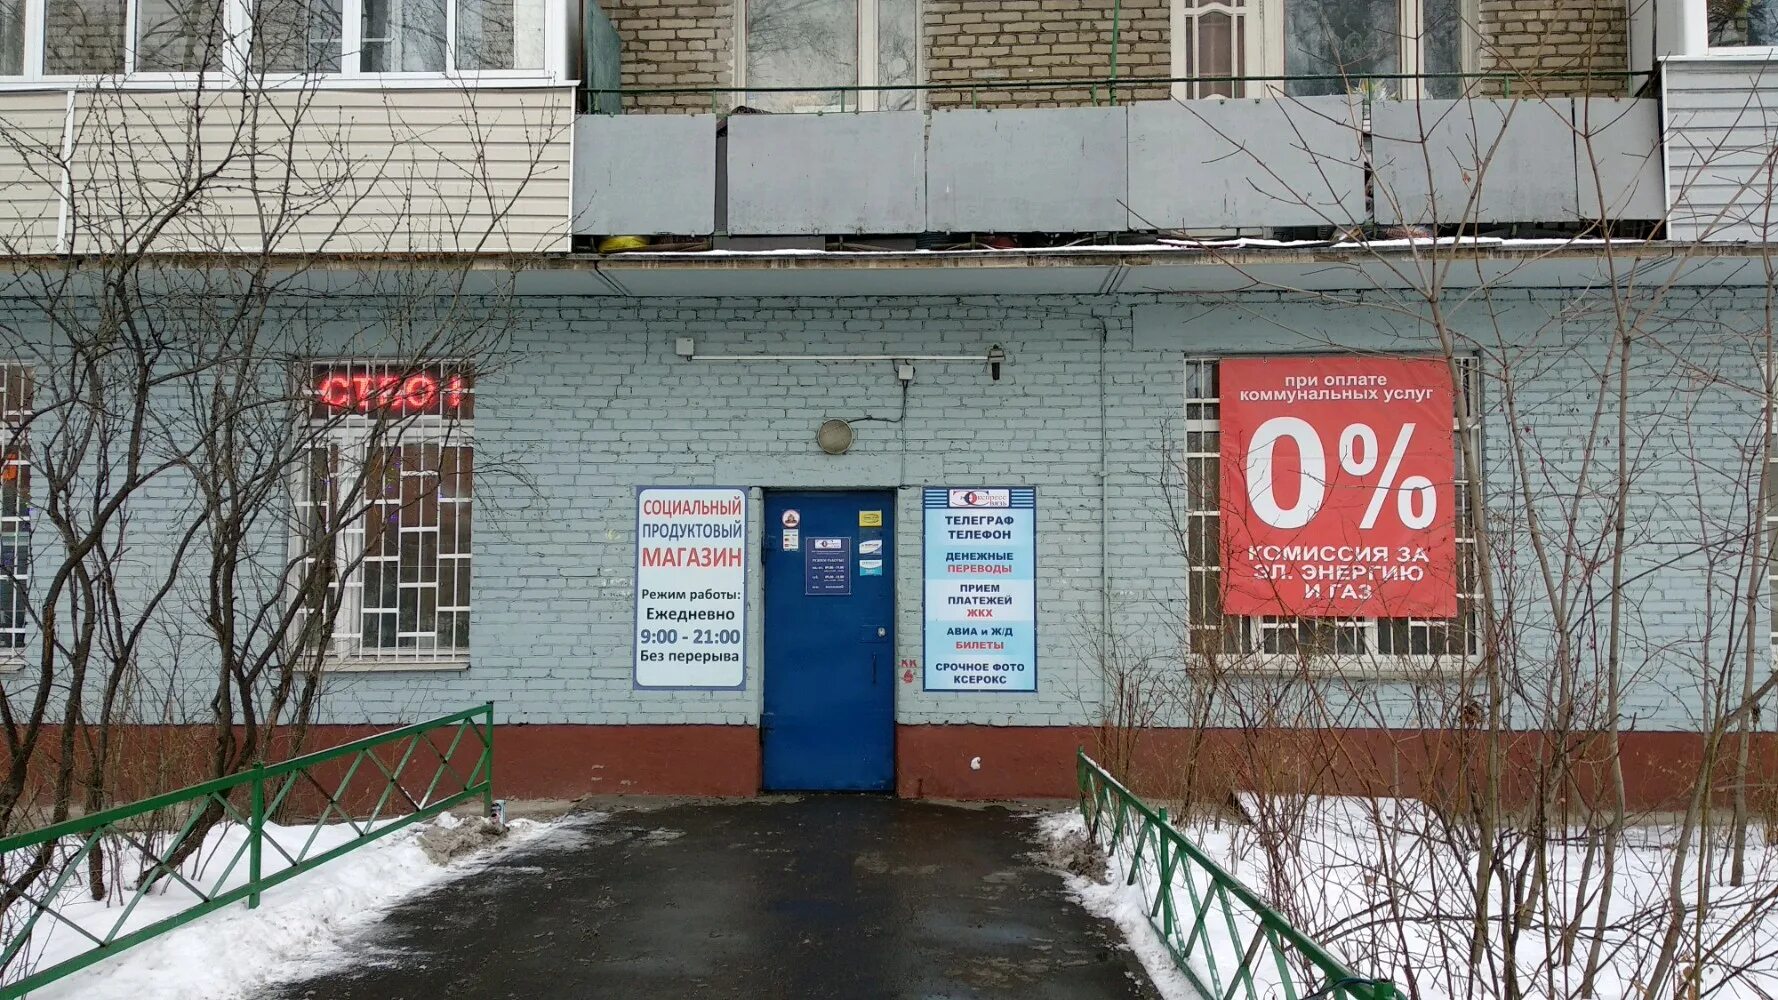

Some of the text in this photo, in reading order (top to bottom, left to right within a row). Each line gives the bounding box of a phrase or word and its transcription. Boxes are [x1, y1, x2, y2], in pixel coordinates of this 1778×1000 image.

[1285, 374, 1388, 388] при оплате
[1240, 388, 1434, 404] коммунальных услуг
[1246, 416, 1438, 531] 0%
[643, 495, 742, 519] СОЦИАЛЬНЫЙ
[945, 516, 1014, 526] ТЕЛЕГРАФ
[642, 519, 742, 542] ПРОДУКТОВЫЙ
[948, 530, 1012, 540] ТЕЛЕФОН
[642, 547, 742, 568] МАГАЗИН
[945, 552, 1014, 562] ДЕНЕЖНЫЕ
[1248, 545, 1430, 563] КОМИССИЯ ЗА
[947, 564, 1012, 574] ПЕРЕВОДЫ
[1301, 564, 1424, 582] ЭНЕРГИЮ
[641, 588, 741, 602] Режим работы:
[960, 584, 1000, 593] ПРИЕМ
[1304, 584, 1373, 600] И ГАЗ
[948, 594, 1013, 605] ПЛАТЕЖЕЙ
[646, 607, 735, 622] Ежедневно
[967, 609, 994, 617] ЖКХ
[640, 628, 678, 644] 9:00
[693, 629, 741, 644] 21:00
[946, 627, 978, 636] АВИА
[991, 627, 1013, 637] Ж/Д
[956, 641, 1004, 650] БИЛЕТЫ
[640, 649, 740, 665] Без перерыва
[935, 662, 1025, 672] СРОЧНОЕ ФОТО
[954, 675, 1007, 684] КСЕРОКС
